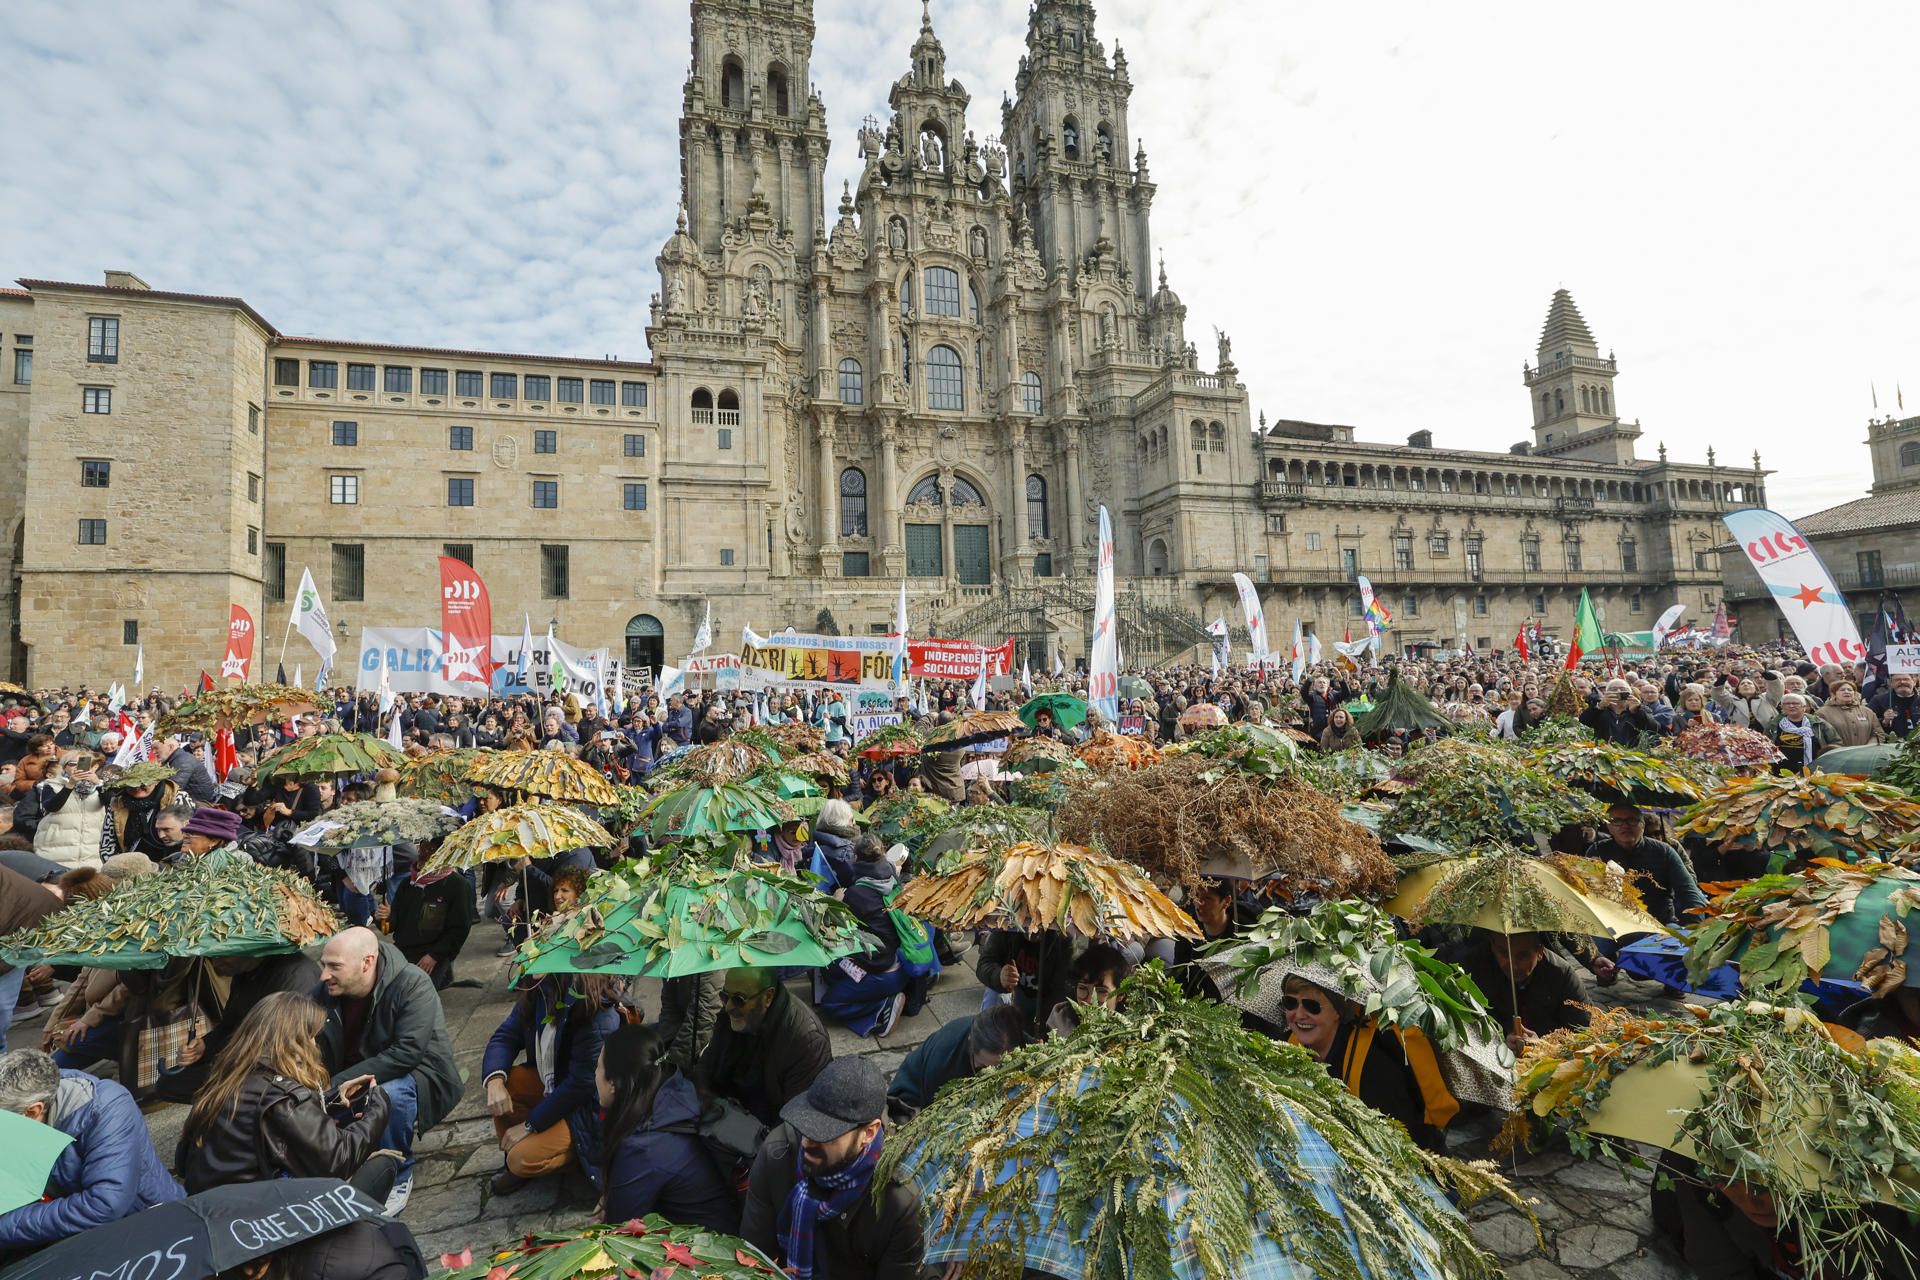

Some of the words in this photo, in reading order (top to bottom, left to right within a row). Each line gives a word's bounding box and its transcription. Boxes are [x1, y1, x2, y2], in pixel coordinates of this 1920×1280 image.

[1747, 531, 1808, 562] CIG
[741, 643, 785, 672] ALTRI
[924, 650, 1006, 664] INDEPENDÊCIA
[1810, 638, 1867, 667] CIG
[689, 656, 730, 672] ALTRI
[923, 663, 981, 676] SOCIALISM
[857, 718, 865, 730] A
[1121, 716, 1144, 728] ALTRI
[1120, 727, 1142, 735] NON
[230, 1213, 299, 1250] QUE
[72, 1236, 194, 1280] MOS
